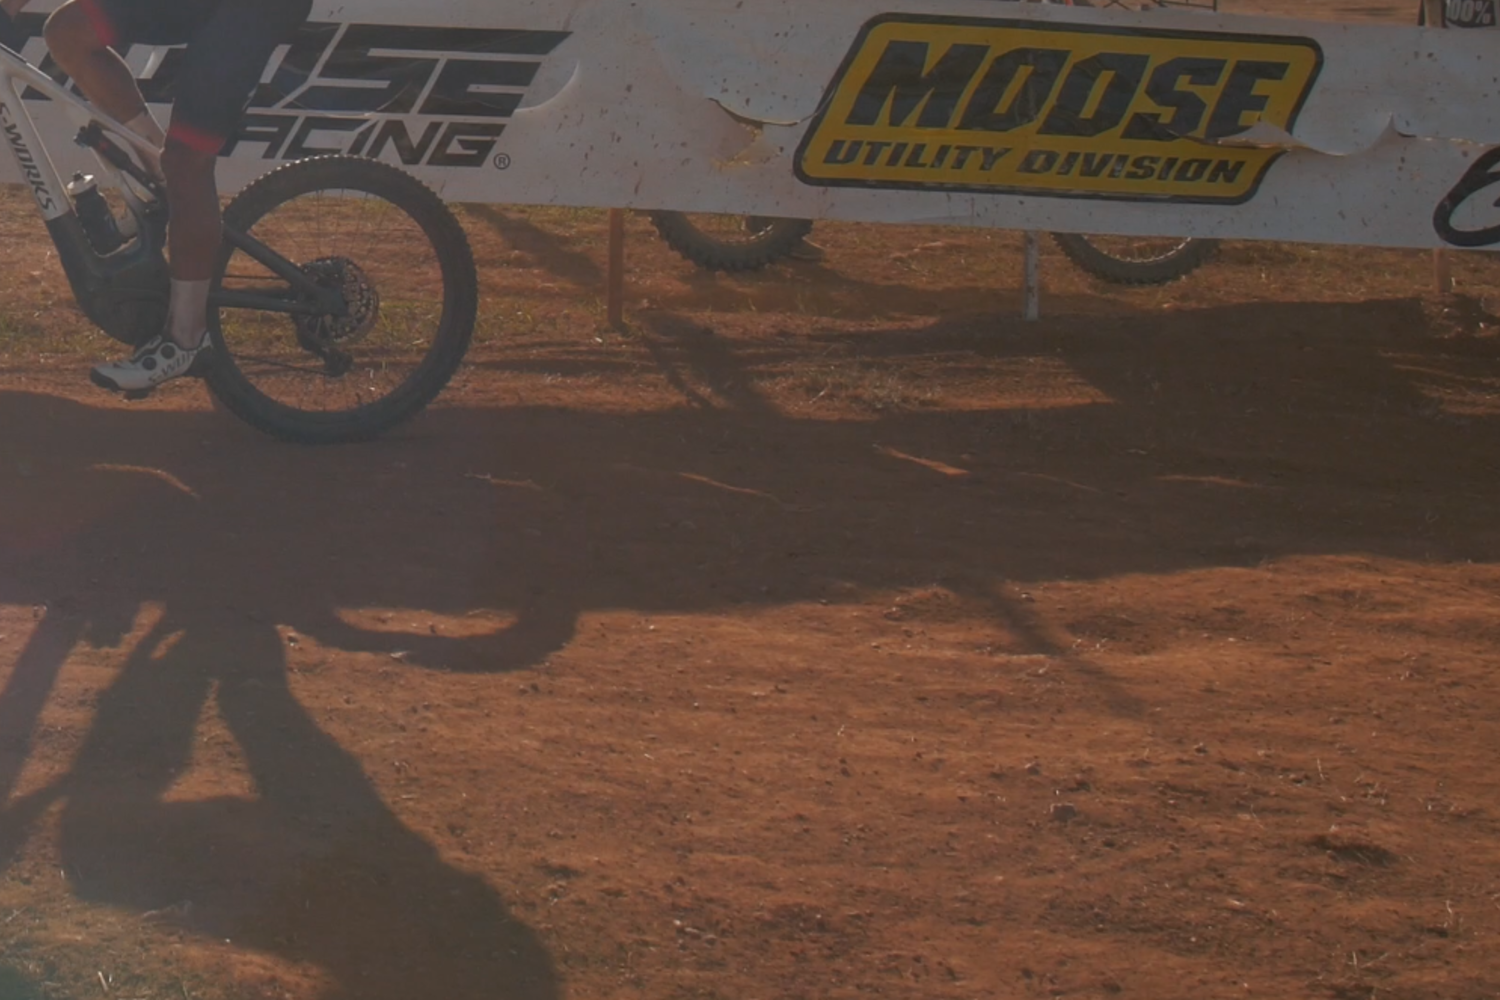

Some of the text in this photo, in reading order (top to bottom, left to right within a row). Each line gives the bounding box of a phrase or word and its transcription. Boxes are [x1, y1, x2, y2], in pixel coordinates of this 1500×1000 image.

[843, 38, 1290, 139] MOOSE
[219, 112, 507, 168] ACING
[822, 138, 1245, 185] UTILITY DIVISION
